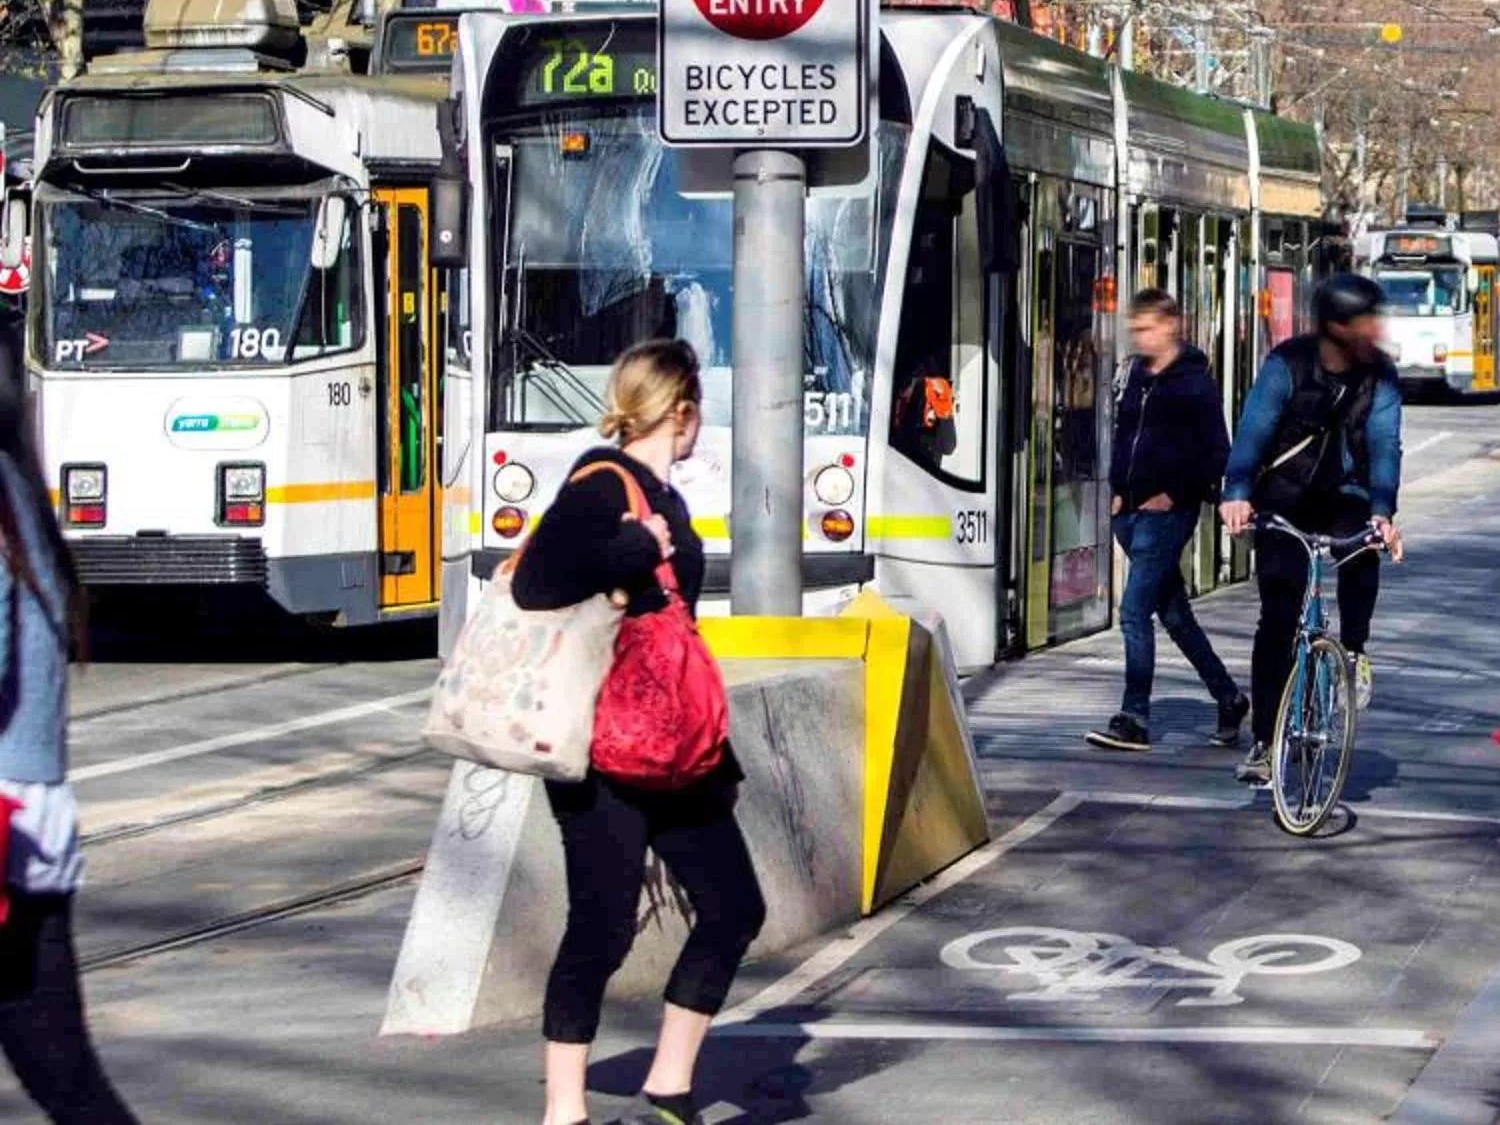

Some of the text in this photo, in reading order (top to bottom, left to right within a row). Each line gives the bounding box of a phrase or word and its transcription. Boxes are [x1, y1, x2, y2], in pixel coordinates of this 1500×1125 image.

[685, 65, 837, 90] BICYCLES
[684, 100, 838, 125] EXCEPTED
[229, 328, 280, 358] 180
[327, 382, 351, 406] 180
[957, 511, 988, 543] 3511
